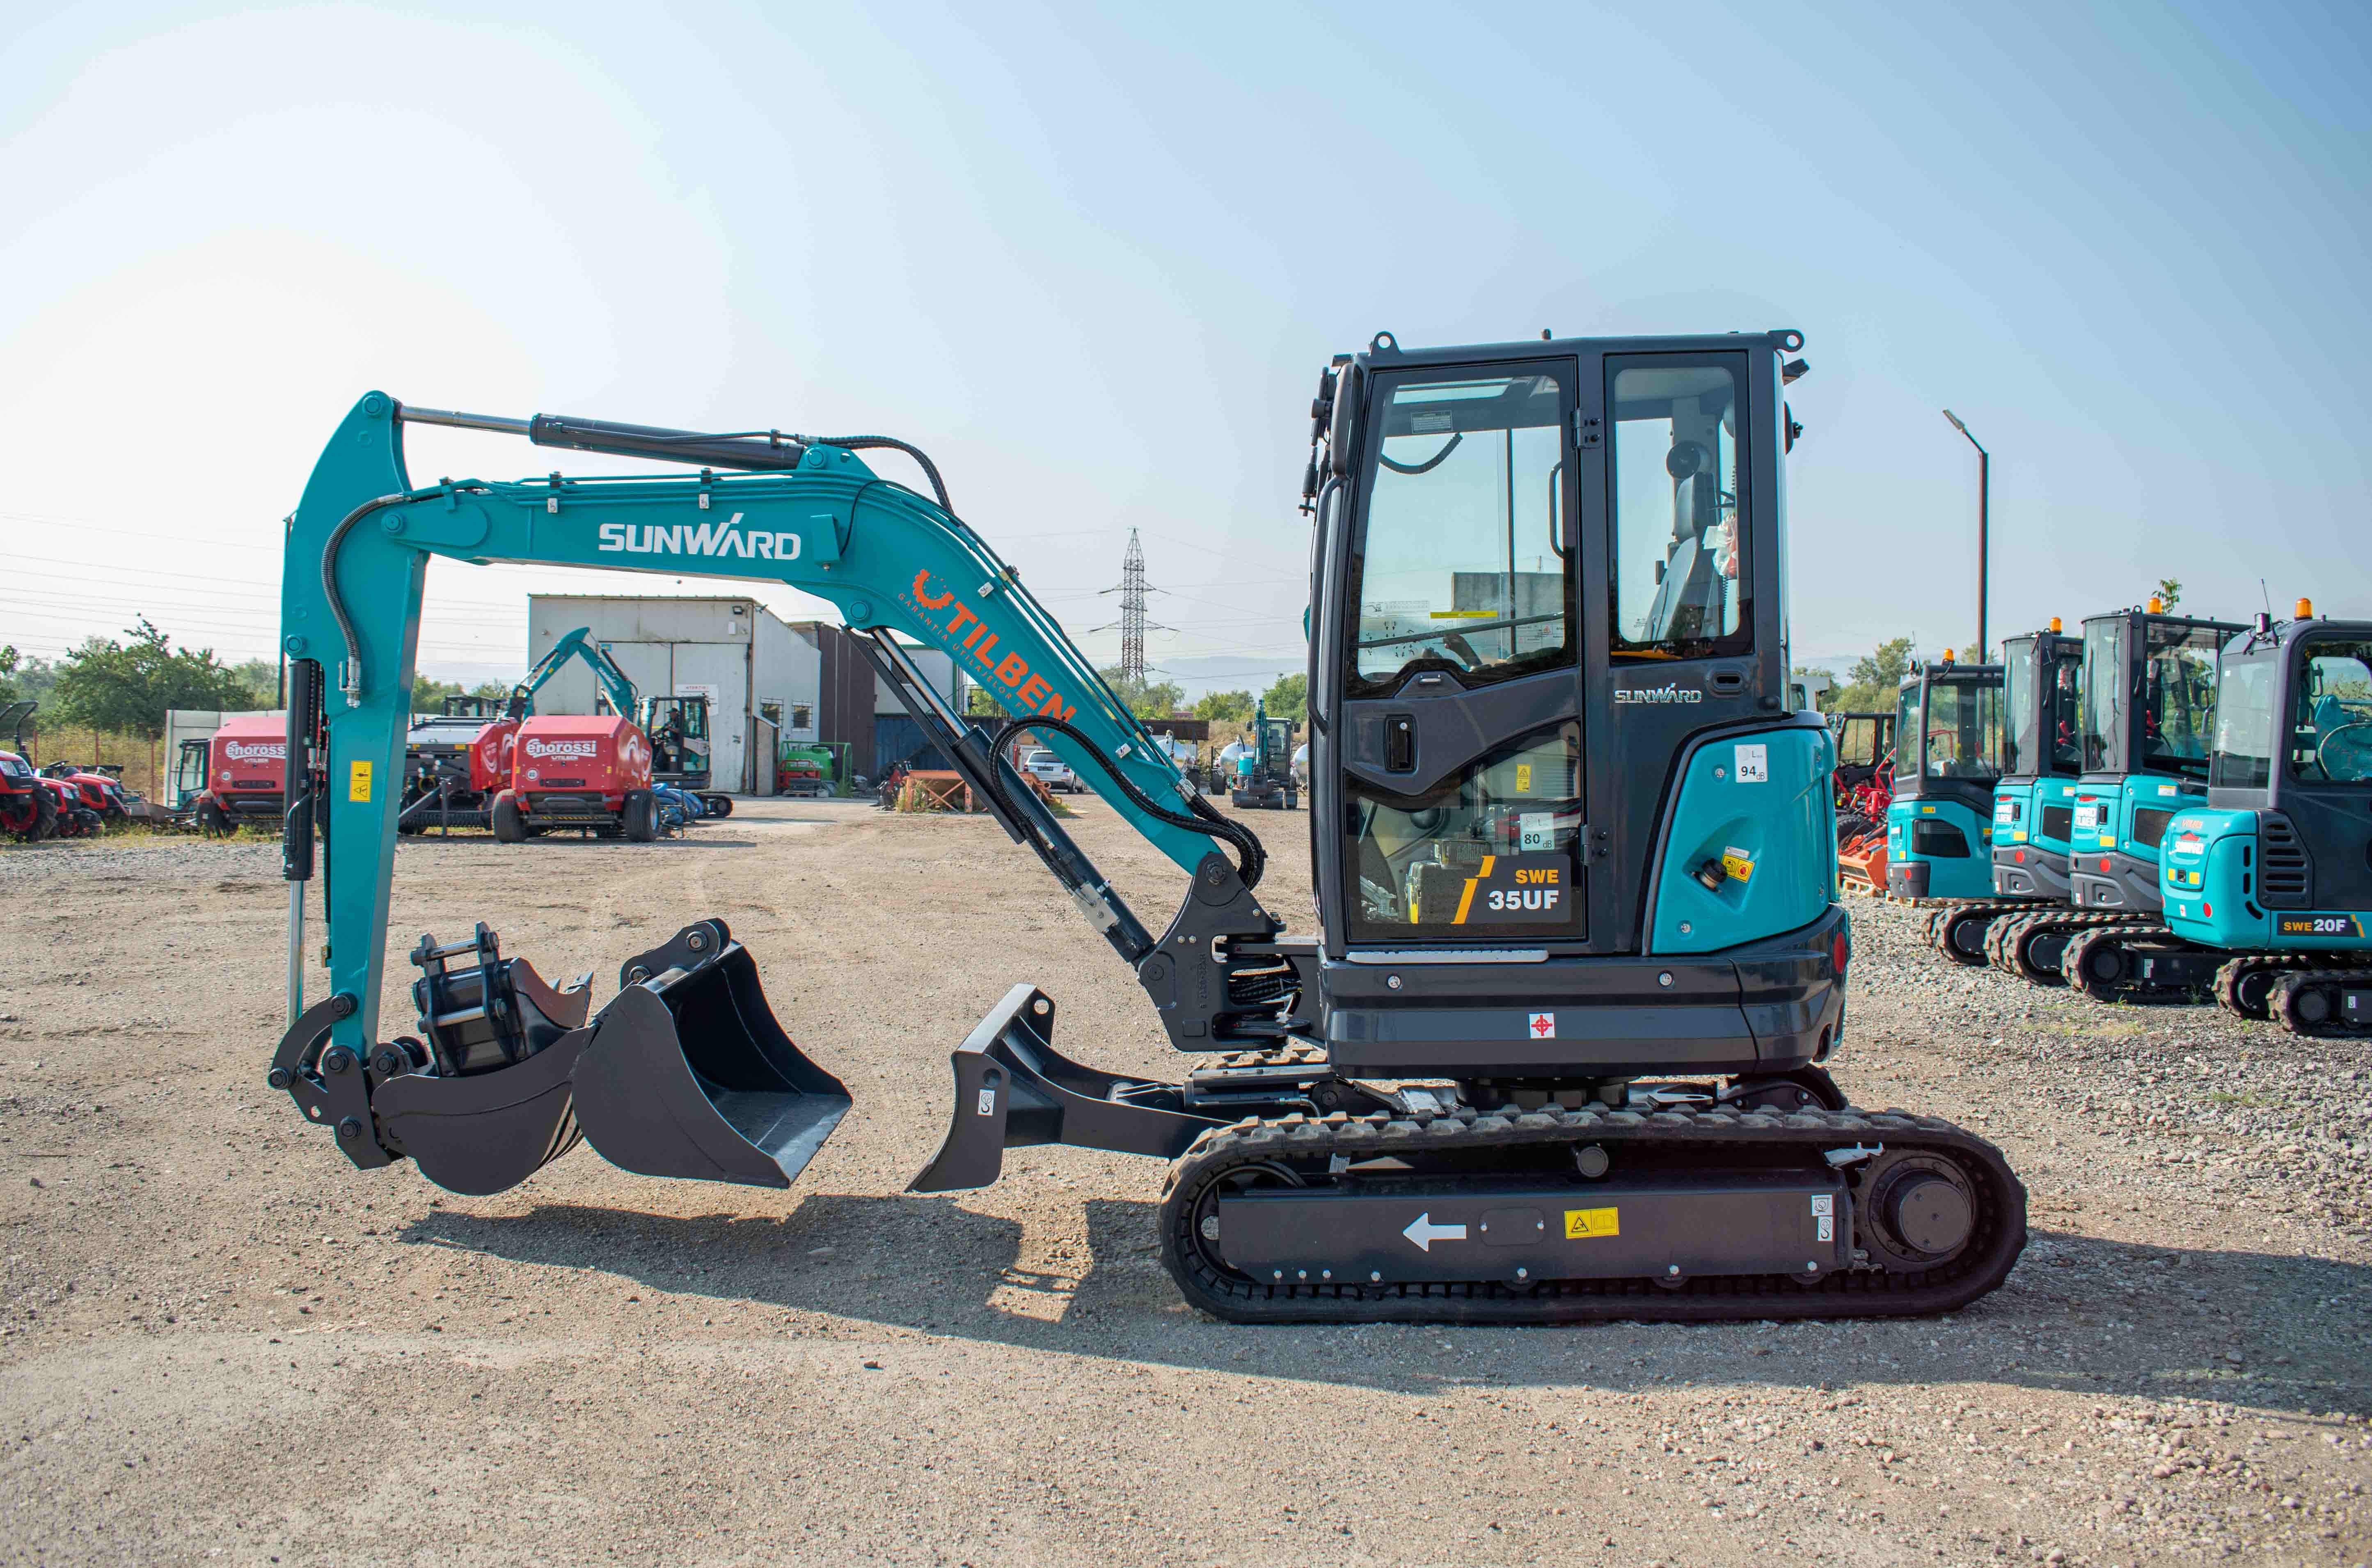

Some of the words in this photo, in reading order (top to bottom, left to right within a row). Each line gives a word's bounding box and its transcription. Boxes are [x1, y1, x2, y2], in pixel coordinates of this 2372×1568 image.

[598, 513, 801, 560] SUNWARD
[952, 643, 1012, 700] UTILAJELOR
[1614, 682, 1702, 703] SUNWARD
[226, 742, 286, 757] enoross
[526, 739, 598, 756] enorossi
[1741, 766, 1756, 776] 94
[1756, 771, 1765, 780] dB
[1524, 834, 1540, 844] 80
[1515, 869, 1559, 884] SWE
[1488, 890, 1559, 910] 35UF
